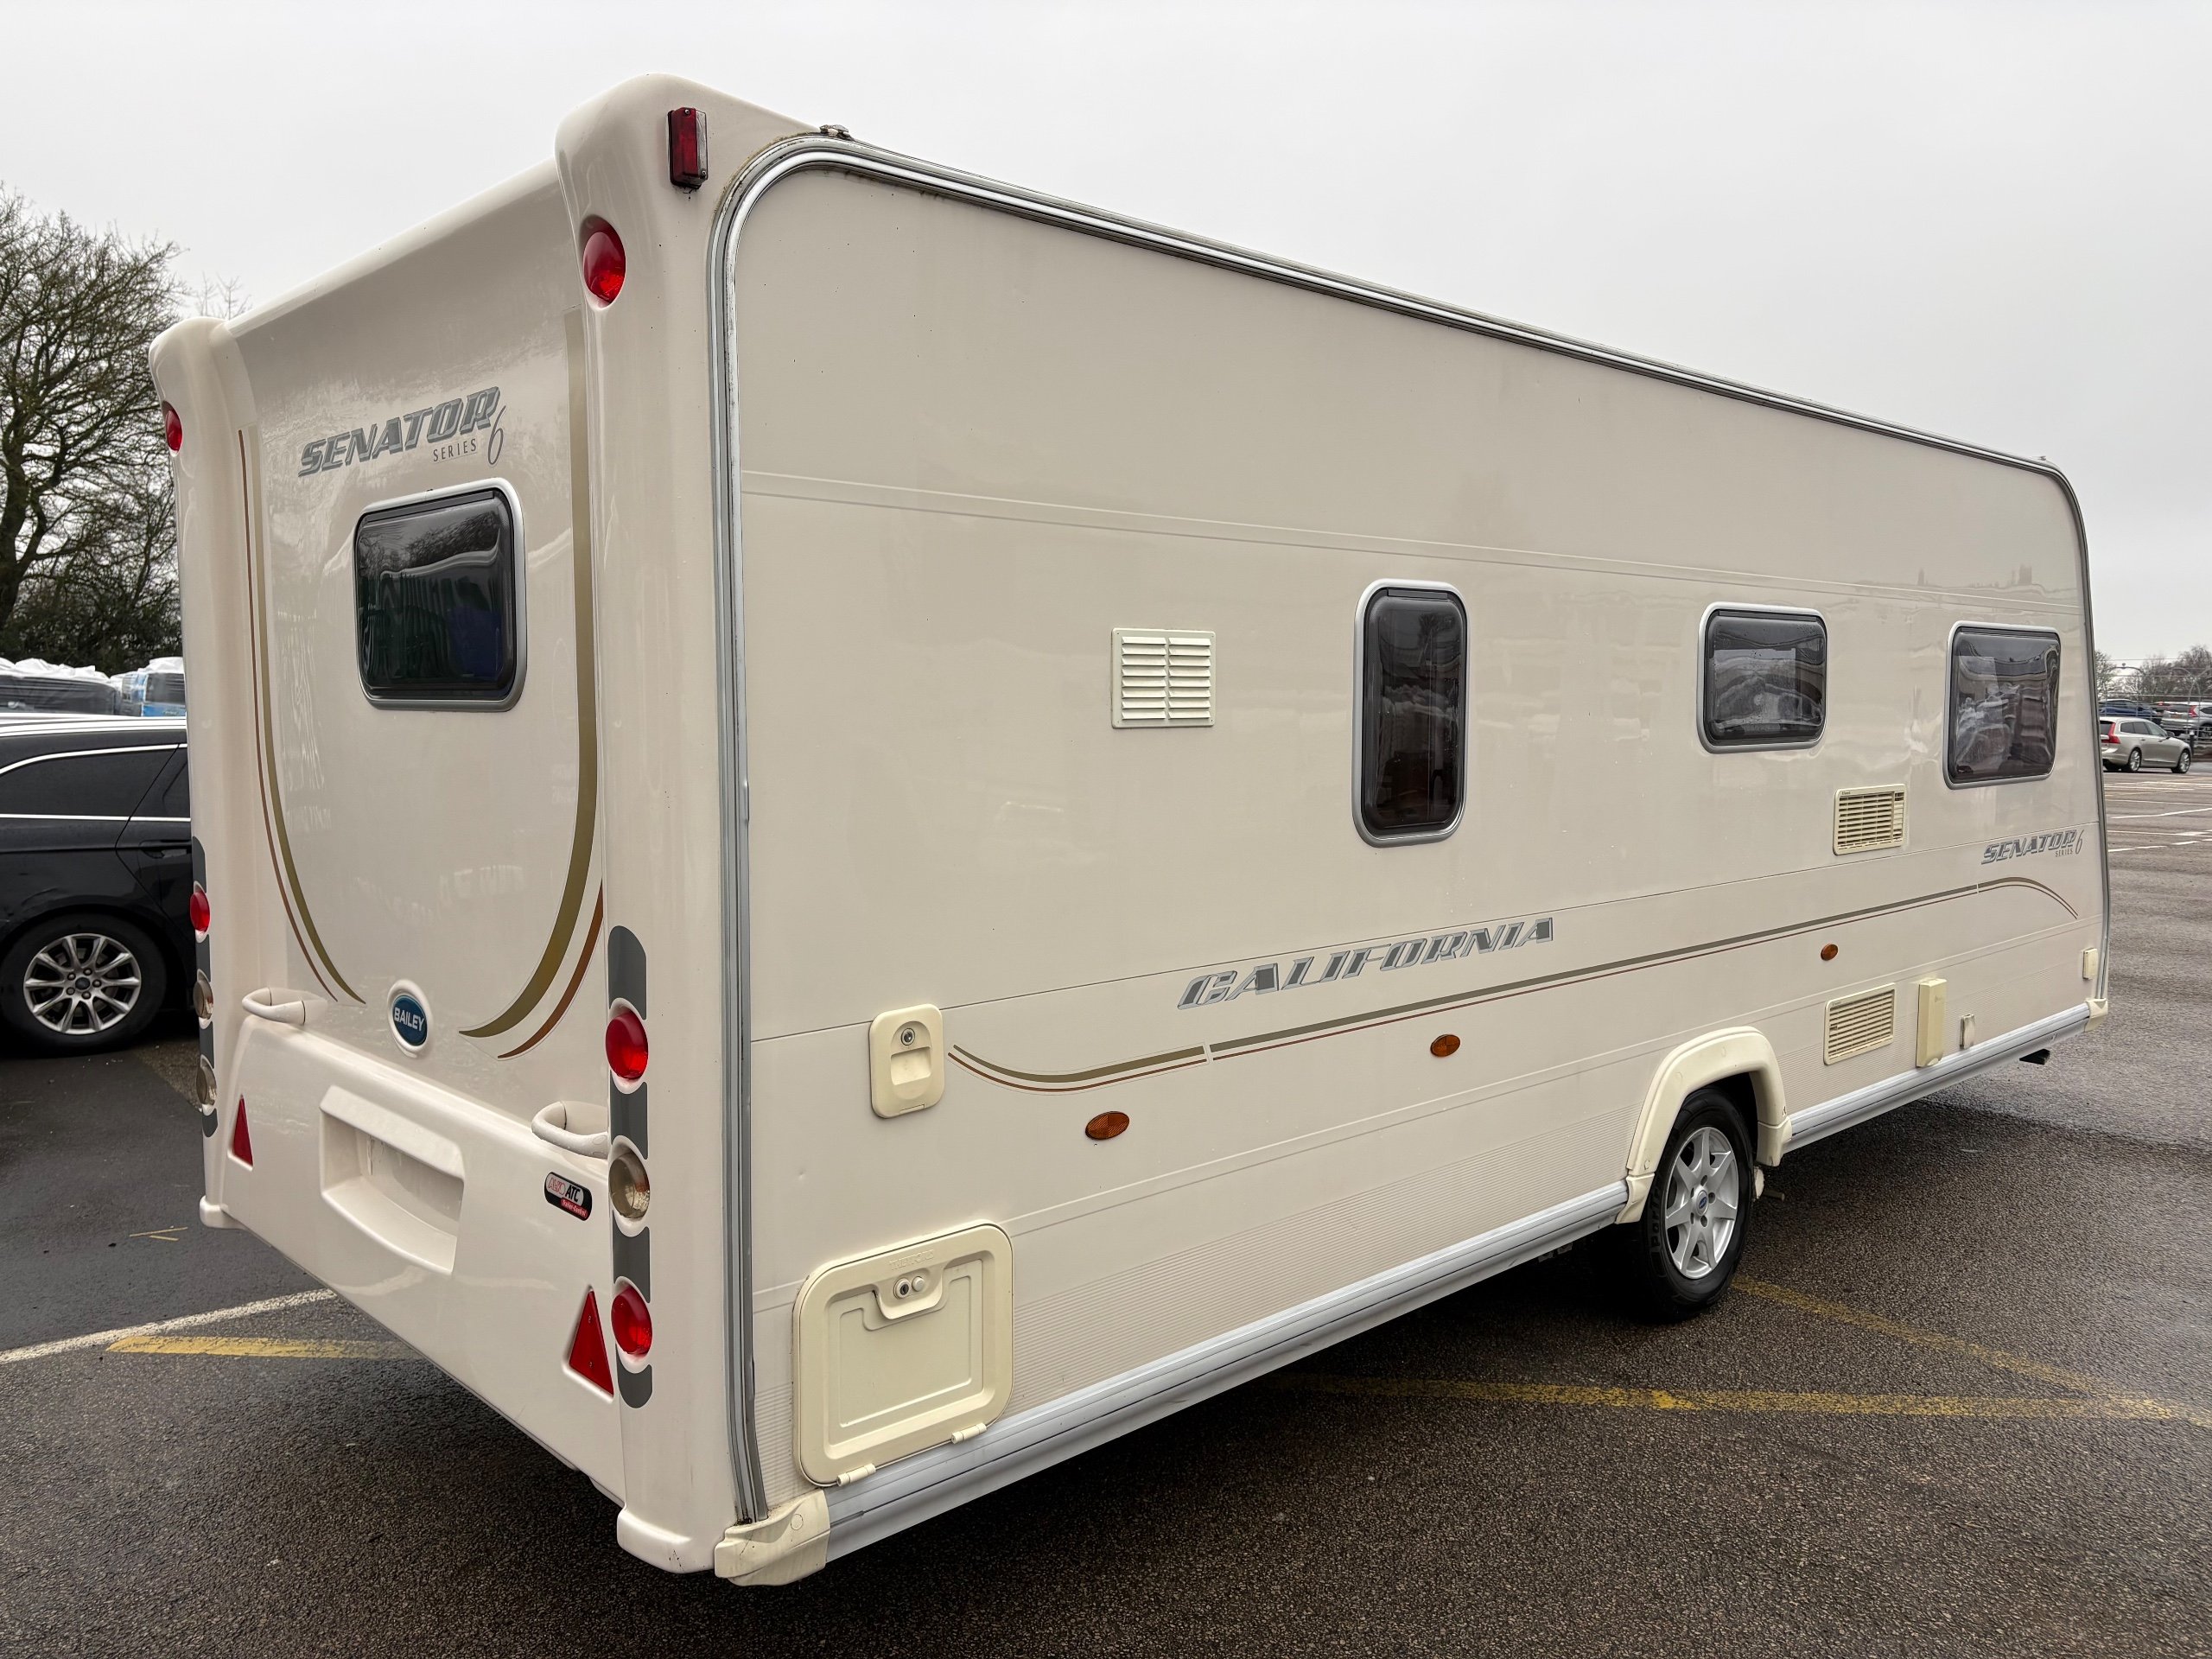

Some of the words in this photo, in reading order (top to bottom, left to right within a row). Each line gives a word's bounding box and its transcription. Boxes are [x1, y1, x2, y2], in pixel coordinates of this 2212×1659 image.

[298, 386, 501, 477] SENATOR
[433, 438, 478, 462] SERIES
[487, 405, 507, 466] 6
[1980, 830, 2078, 865] SENATOR
[2055, 848, 2074, 857] SERIES
[2075, 830, 2085, 855] 6
[1177, 917, 1554, 1010] CALIFORNIA
[394, 1007, 425, 1032] BAILEY
[564, 1184, 581, 1203] ATC
